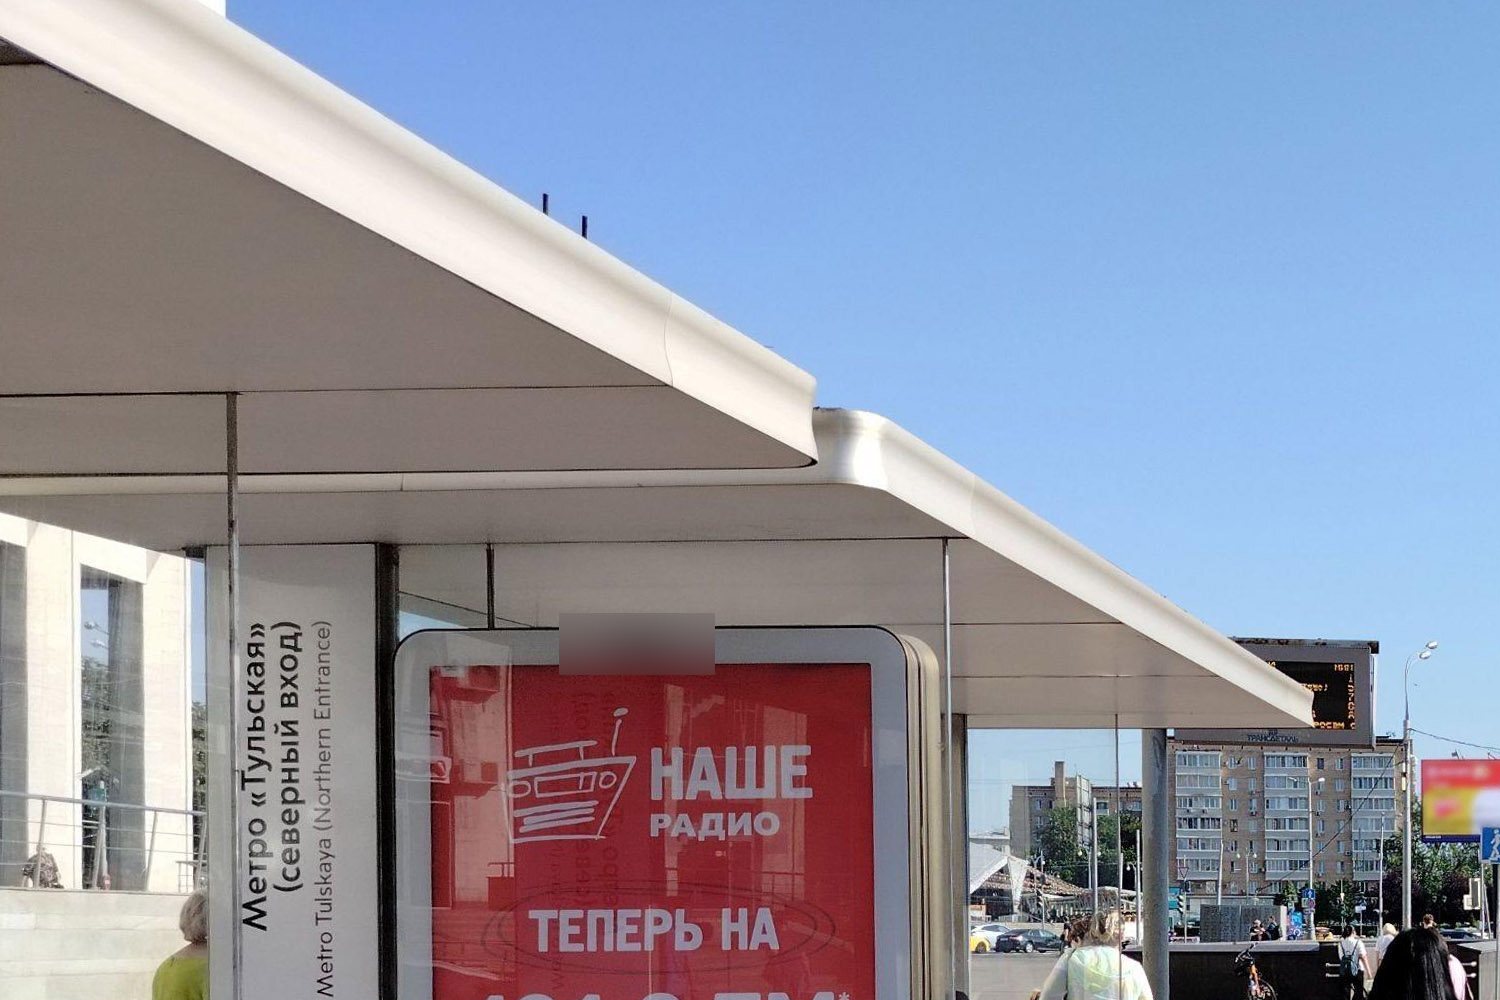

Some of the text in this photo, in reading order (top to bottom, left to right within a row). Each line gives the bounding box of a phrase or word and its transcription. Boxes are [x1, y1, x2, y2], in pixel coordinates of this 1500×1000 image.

[241, 623, 274, 931] Метро «Тульская»
[270, 622, 306, 892] (северный вход)
[311, 621, 335, 997] Metro Tulskaya (Northern Entrance)
[650, 744, 813, 801] НАШЕ
[650, 811, 781, 841] РАДИО
[528, 906, 780, 953] ТЕПЕРЬ НА
